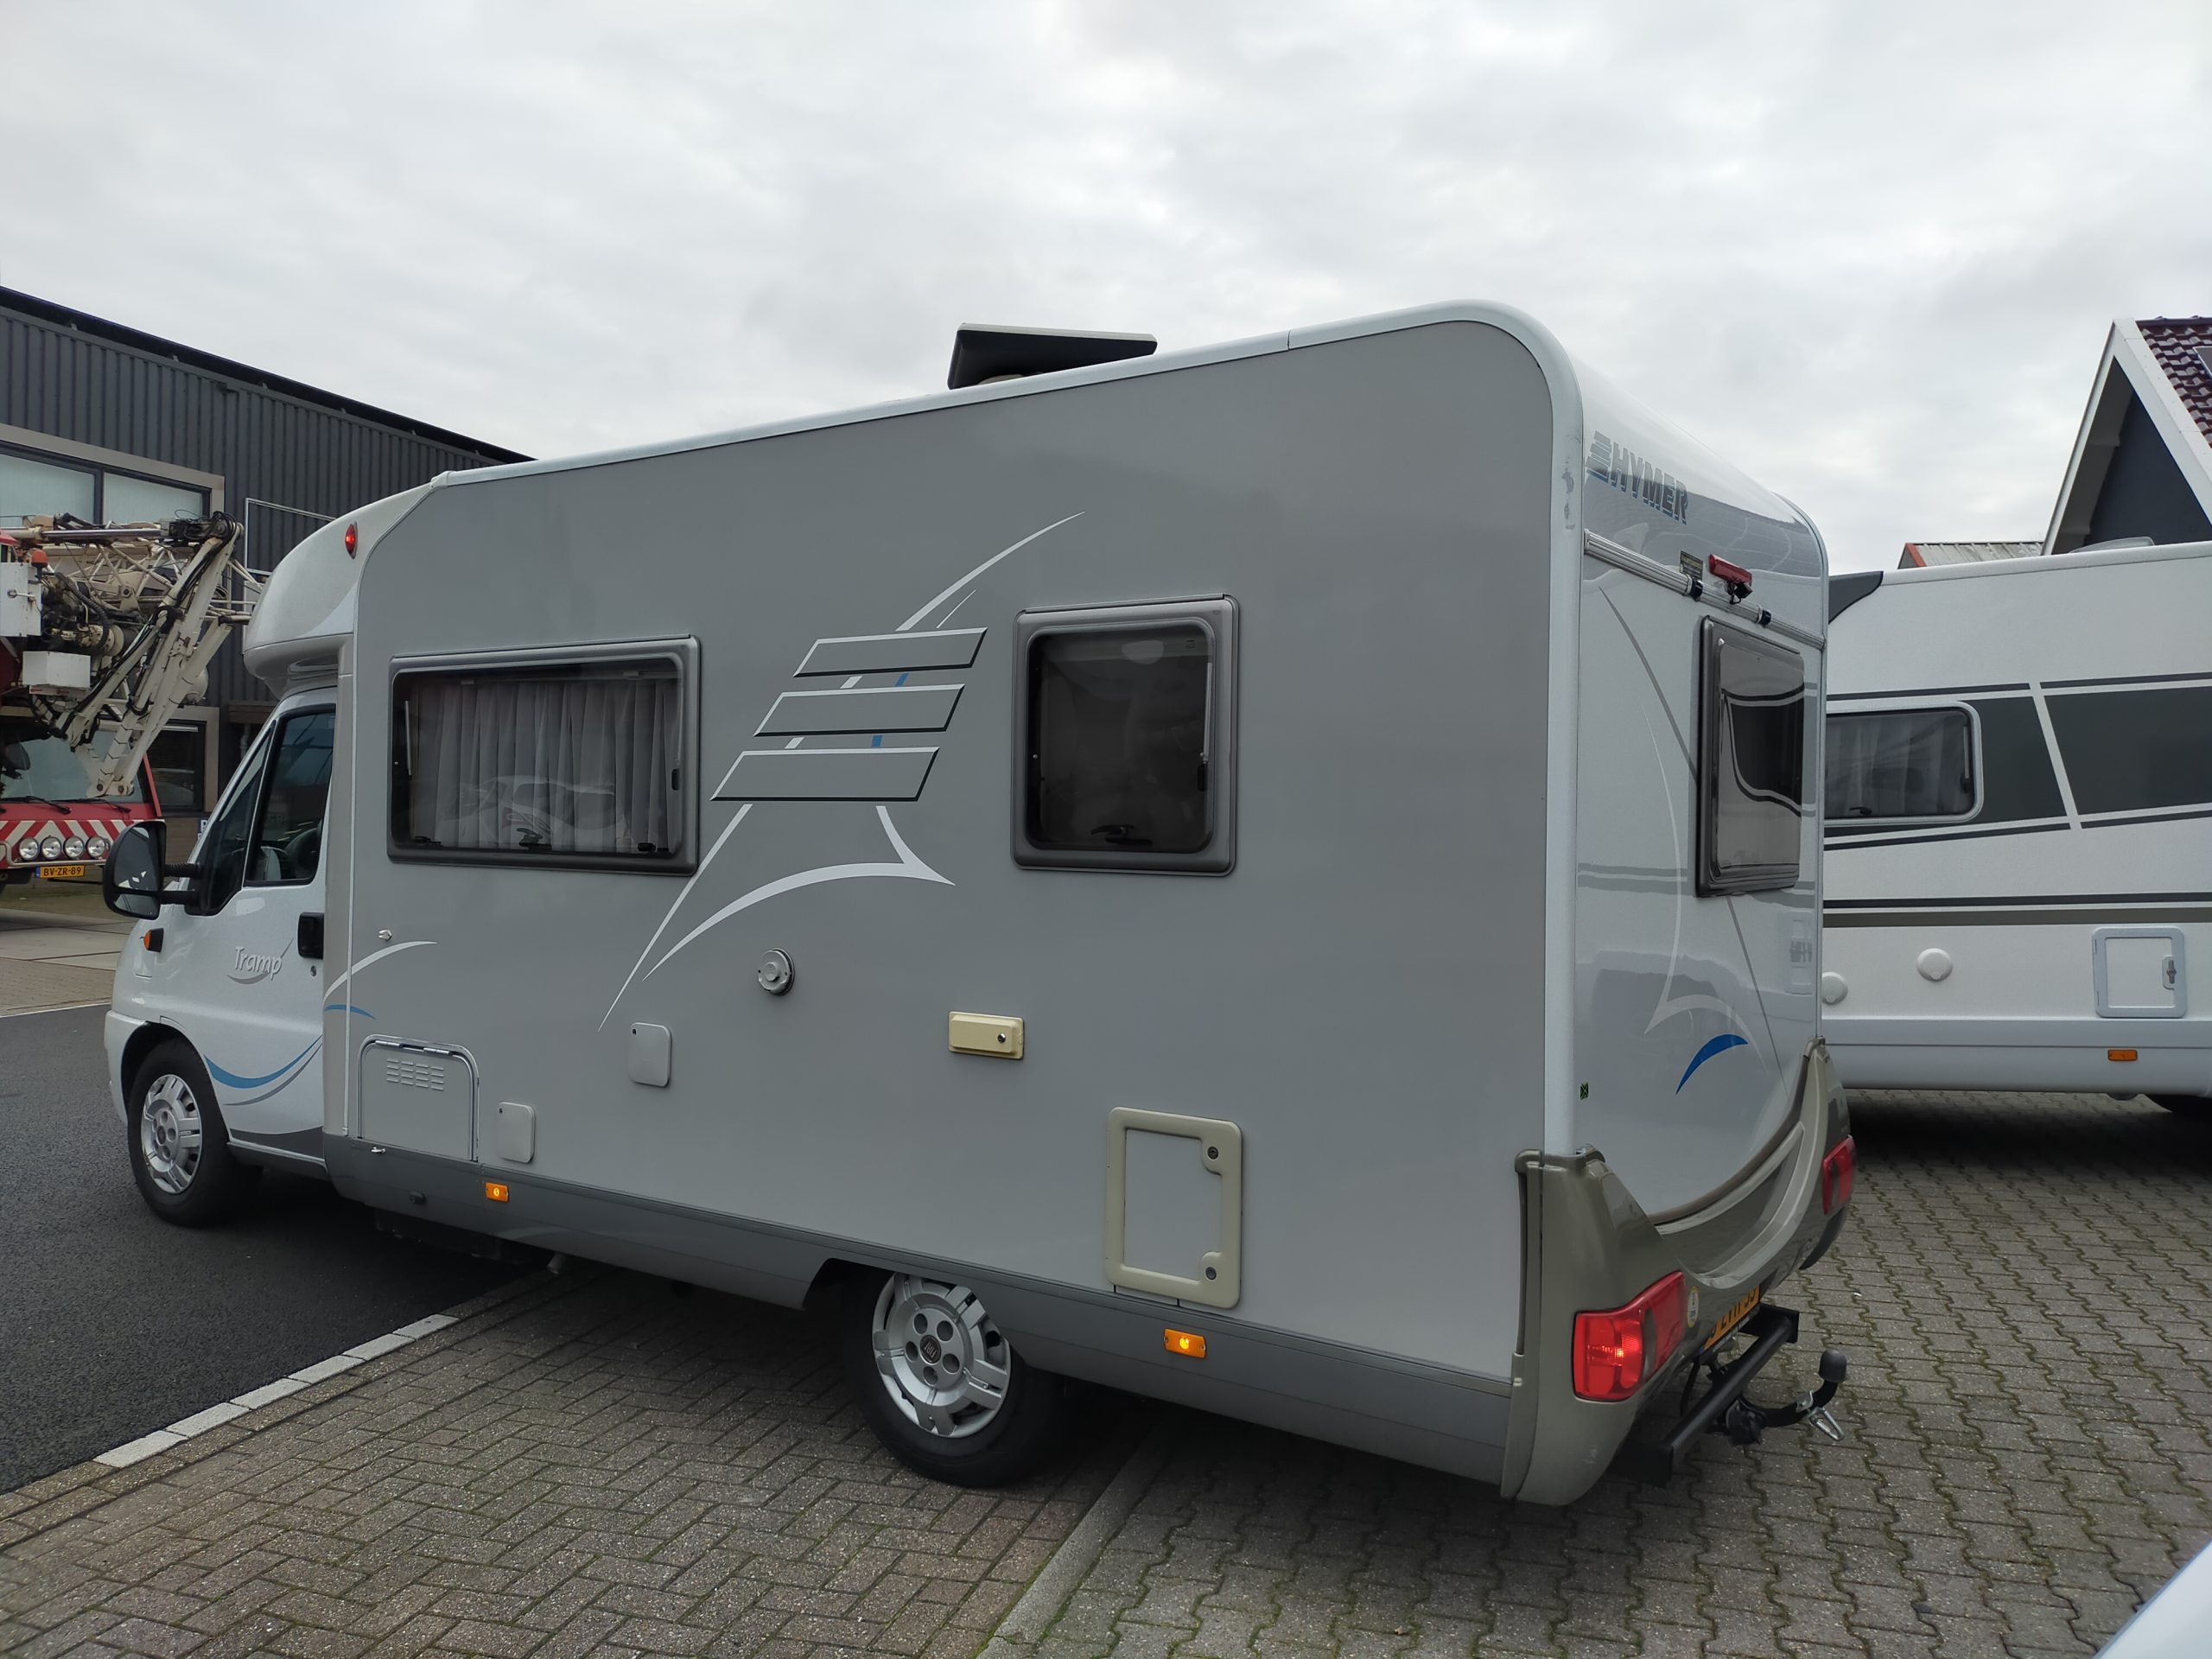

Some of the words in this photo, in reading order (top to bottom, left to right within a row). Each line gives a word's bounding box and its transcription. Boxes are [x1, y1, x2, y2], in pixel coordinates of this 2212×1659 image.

[1610, 442, 1688, 525] HYMER
[43, 867, 81, 876] BV-ZR-89
[234, 945, 283, 981] Tramp
[924, 1341, 938, 1358] FIAT
